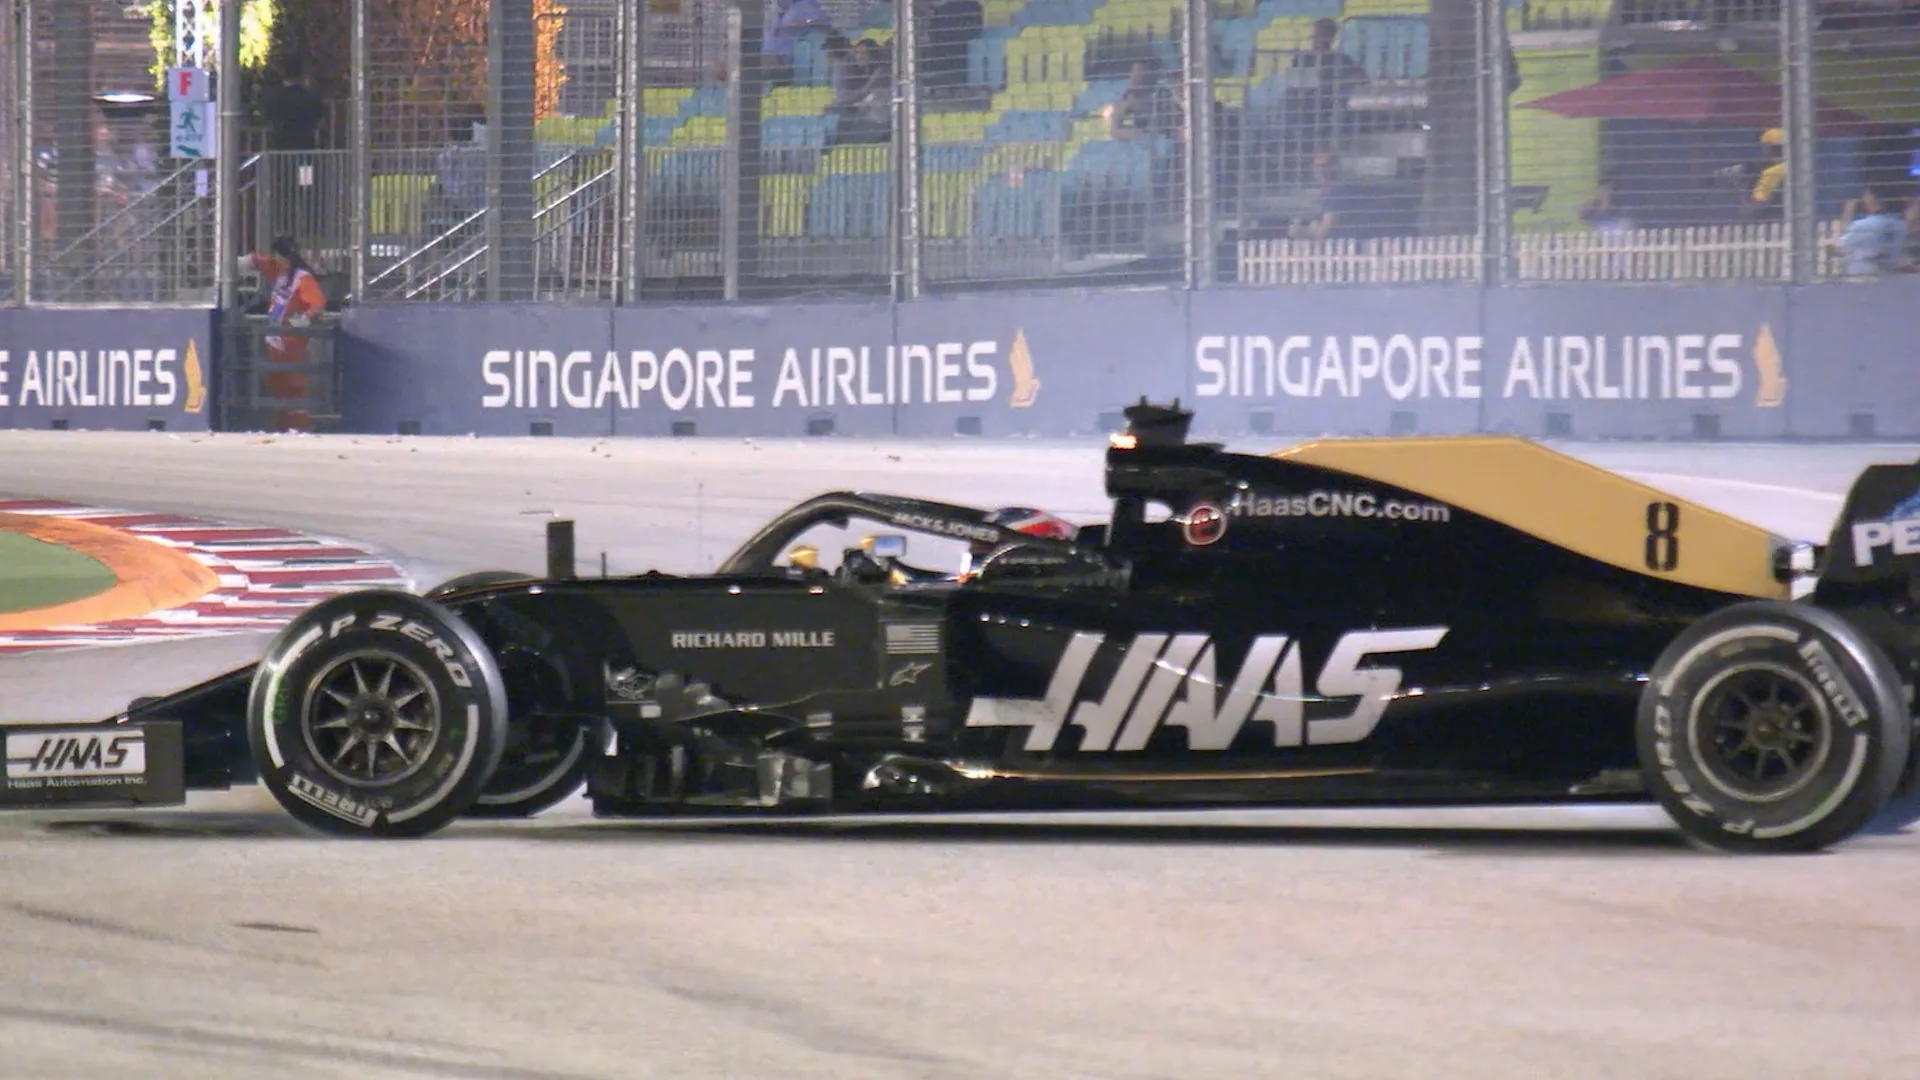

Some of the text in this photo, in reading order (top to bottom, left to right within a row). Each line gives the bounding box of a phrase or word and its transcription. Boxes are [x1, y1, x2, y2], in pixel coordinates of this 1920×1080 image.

[179, 71, 196, 97] F
[20, 349, 176, 406] AIRLINES
[483, 341, 997, 410] SINGAPORE AIRLINES
[1196, 334, 1740, 400] SINGAPORE AIRLINES
[1233, 490, 1451, 523] HaasCNC.com
[1645, 502, 1678, 572] 8
[369, 614, 473, 688] ZERO
[671, 631, 834, 648] RICHARD MILLE
[966, 628, 1448, 751] HAAS
[6, 736, 144, 772] HAAS
[46, 777, 122, 788] Automation
[288, 773, 379, 828] PIRELLI
